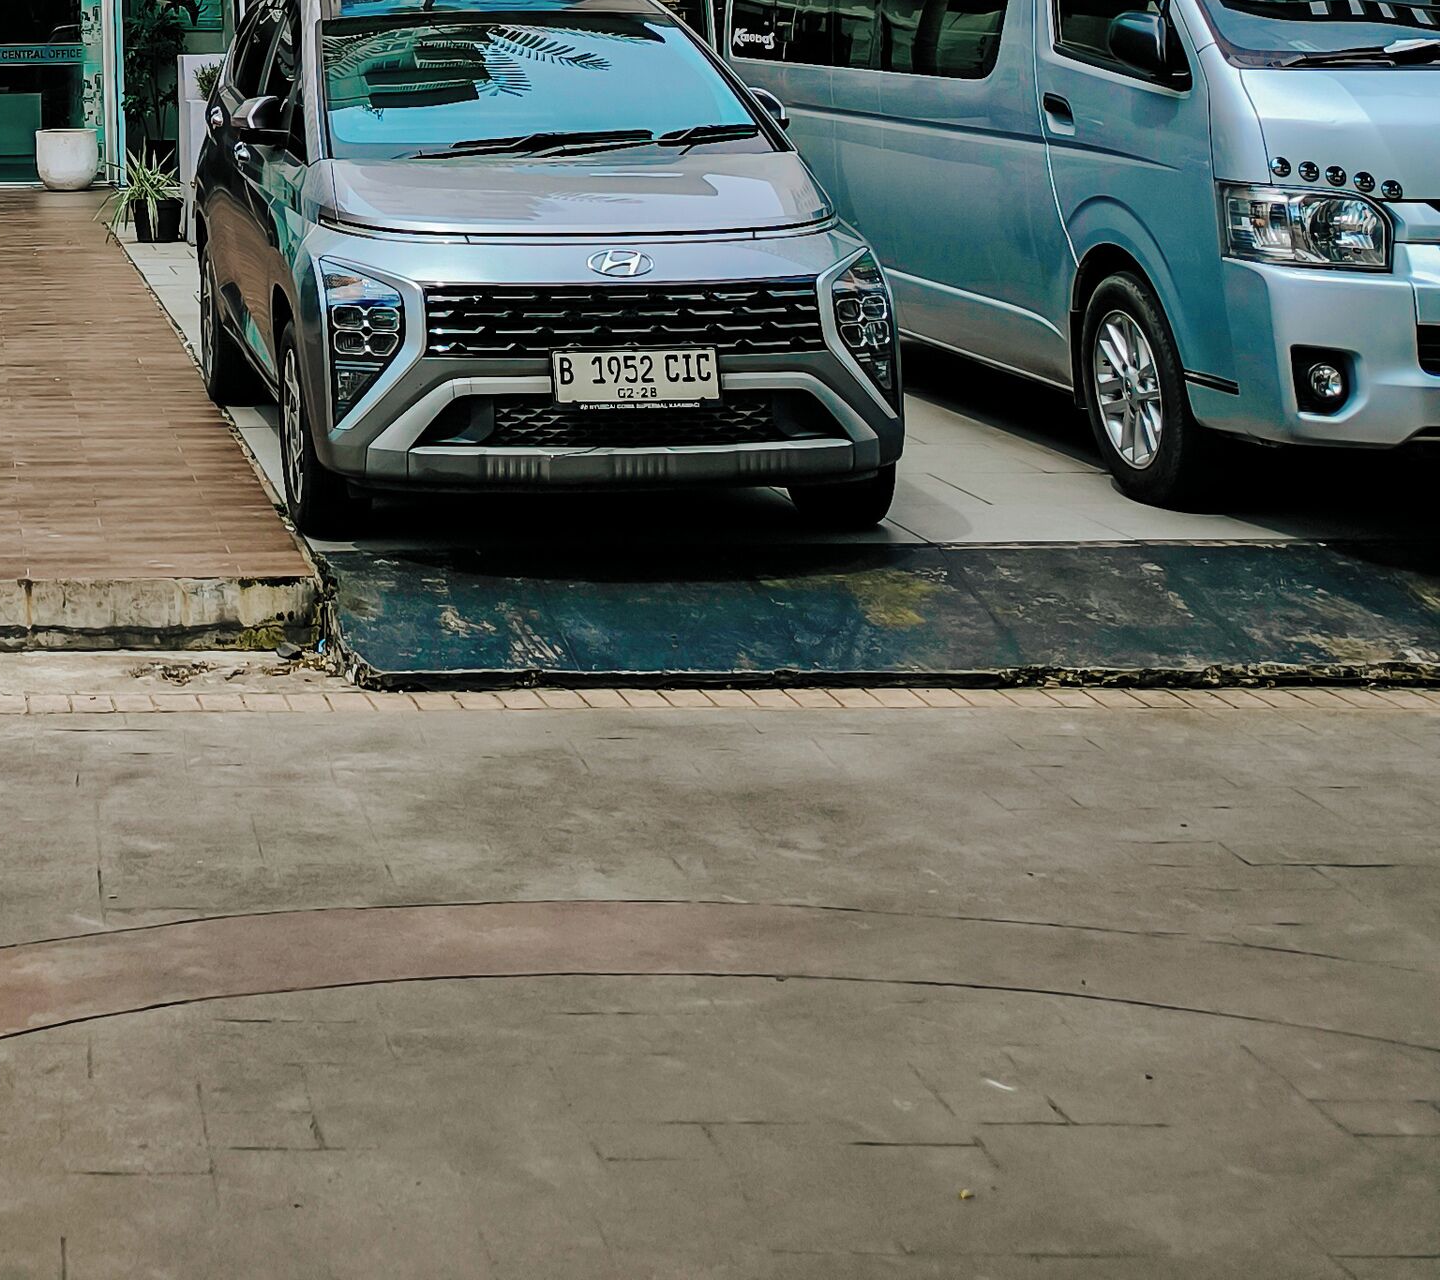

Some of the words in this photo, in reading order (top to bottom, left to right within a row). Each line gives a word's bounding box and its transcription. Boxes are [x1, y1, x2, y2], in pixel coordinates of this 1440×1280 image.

[1, 49, 47, 60] CENTRAL
[48, 48, 83, 59] OFFICE
[560, 357, 574, 385] B
[591, 355, 655, 384] 1952
[664, 353, 711, 382] CIC
